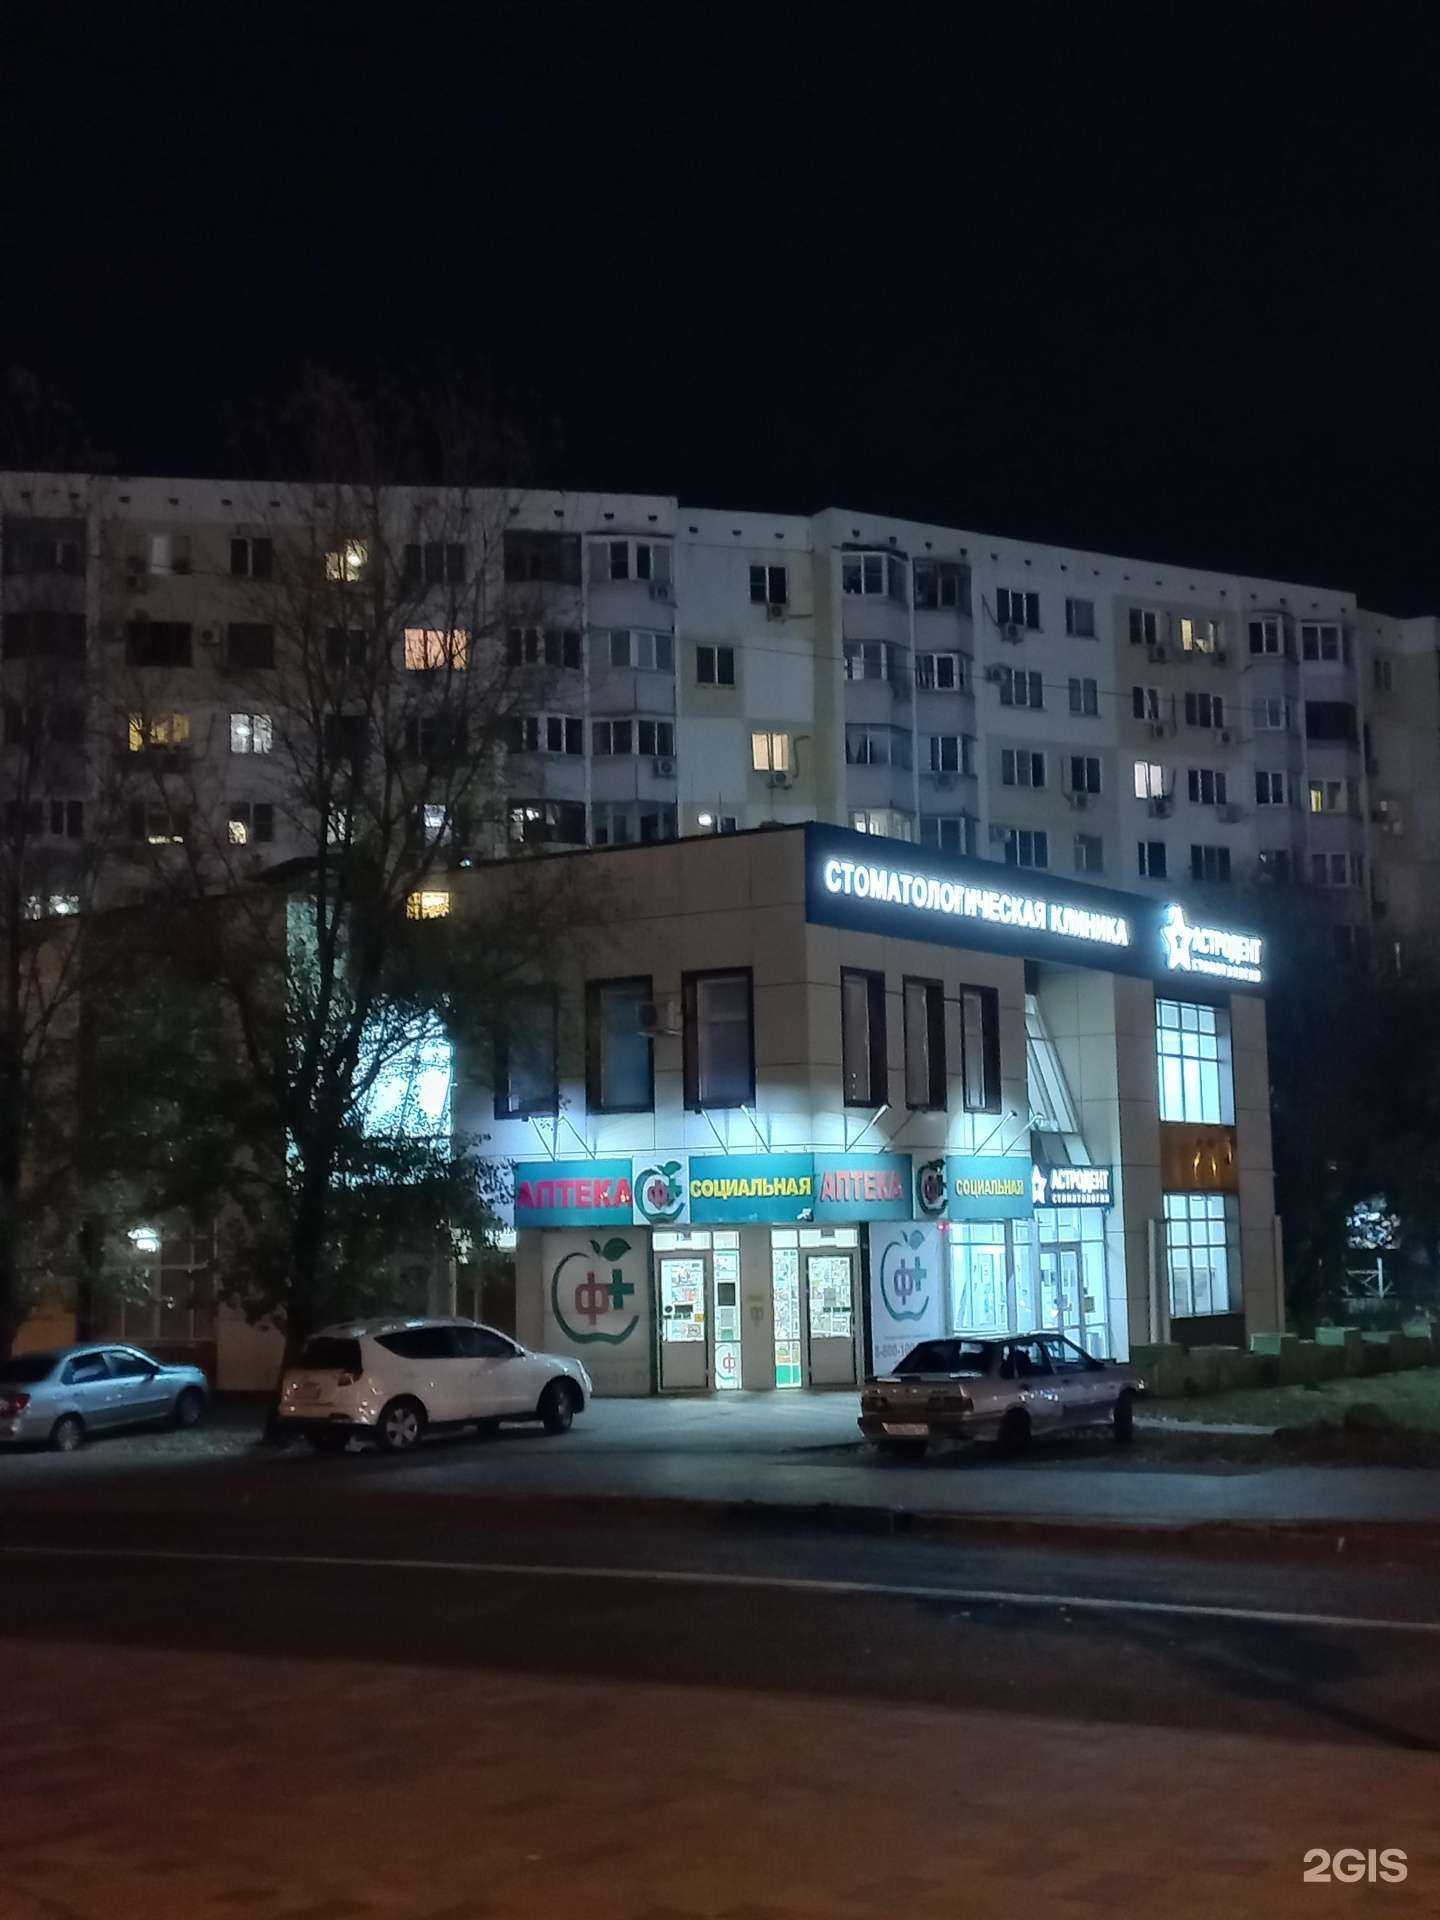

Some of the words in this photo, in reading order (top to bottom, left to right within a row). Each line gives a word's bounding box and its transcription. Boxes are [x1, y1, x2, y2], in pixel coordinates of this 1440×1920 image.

[825, 859, 1047, 930] СТОМАТОЛОГИЧЕСКАЯ
[1050, 904, 1129, 947] КЛИНИКА
[517, 1178, 633, 1210] АПТЕКА
[690, 1176, 813, 1201] СОЦИАЛЬНАЯ
[820, 1171, 902, 1202] АПТЕКА
[955, 1178, 1025, 1199] СОЦИАЛЬНАЯ
